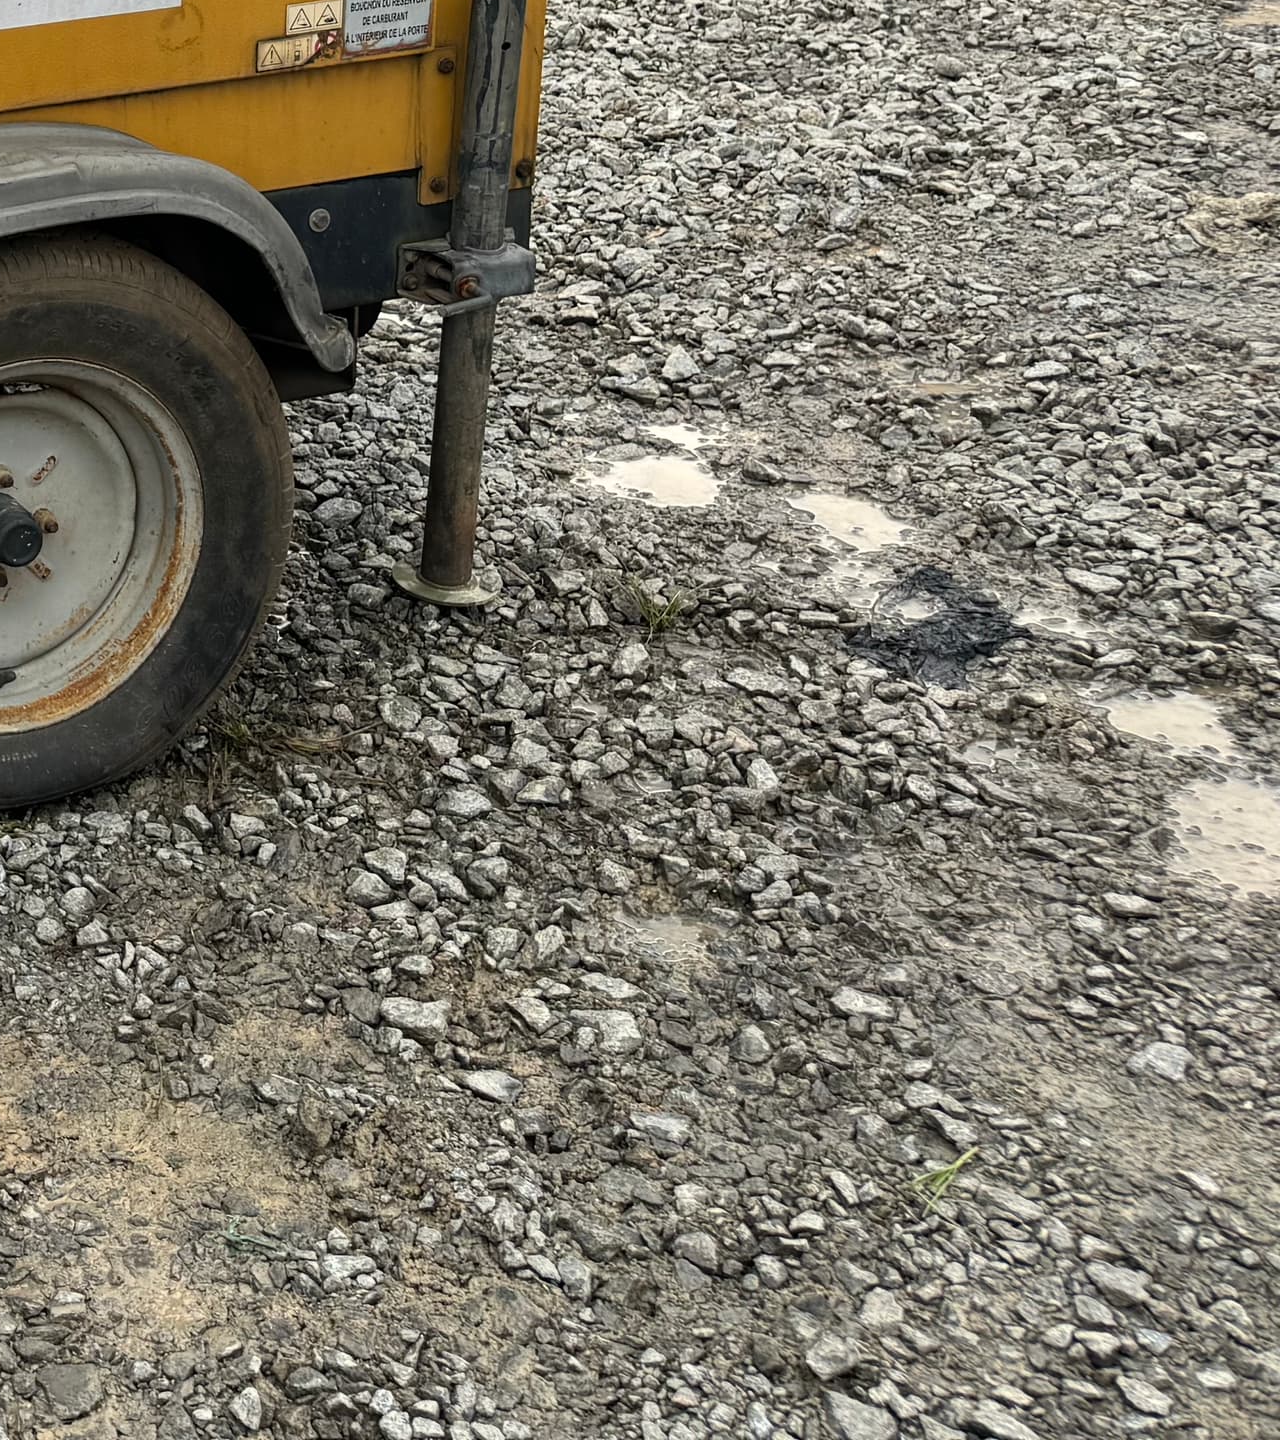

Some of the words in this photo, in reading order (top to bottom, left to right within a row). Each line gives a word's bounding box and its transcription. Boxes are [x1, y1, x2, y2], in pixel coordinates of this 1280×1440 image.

[350, 0, 381, 13] BOUCHON
[372, 11, 408, 25] CARBURANT
[407, 24, 429, 36] PORTE
